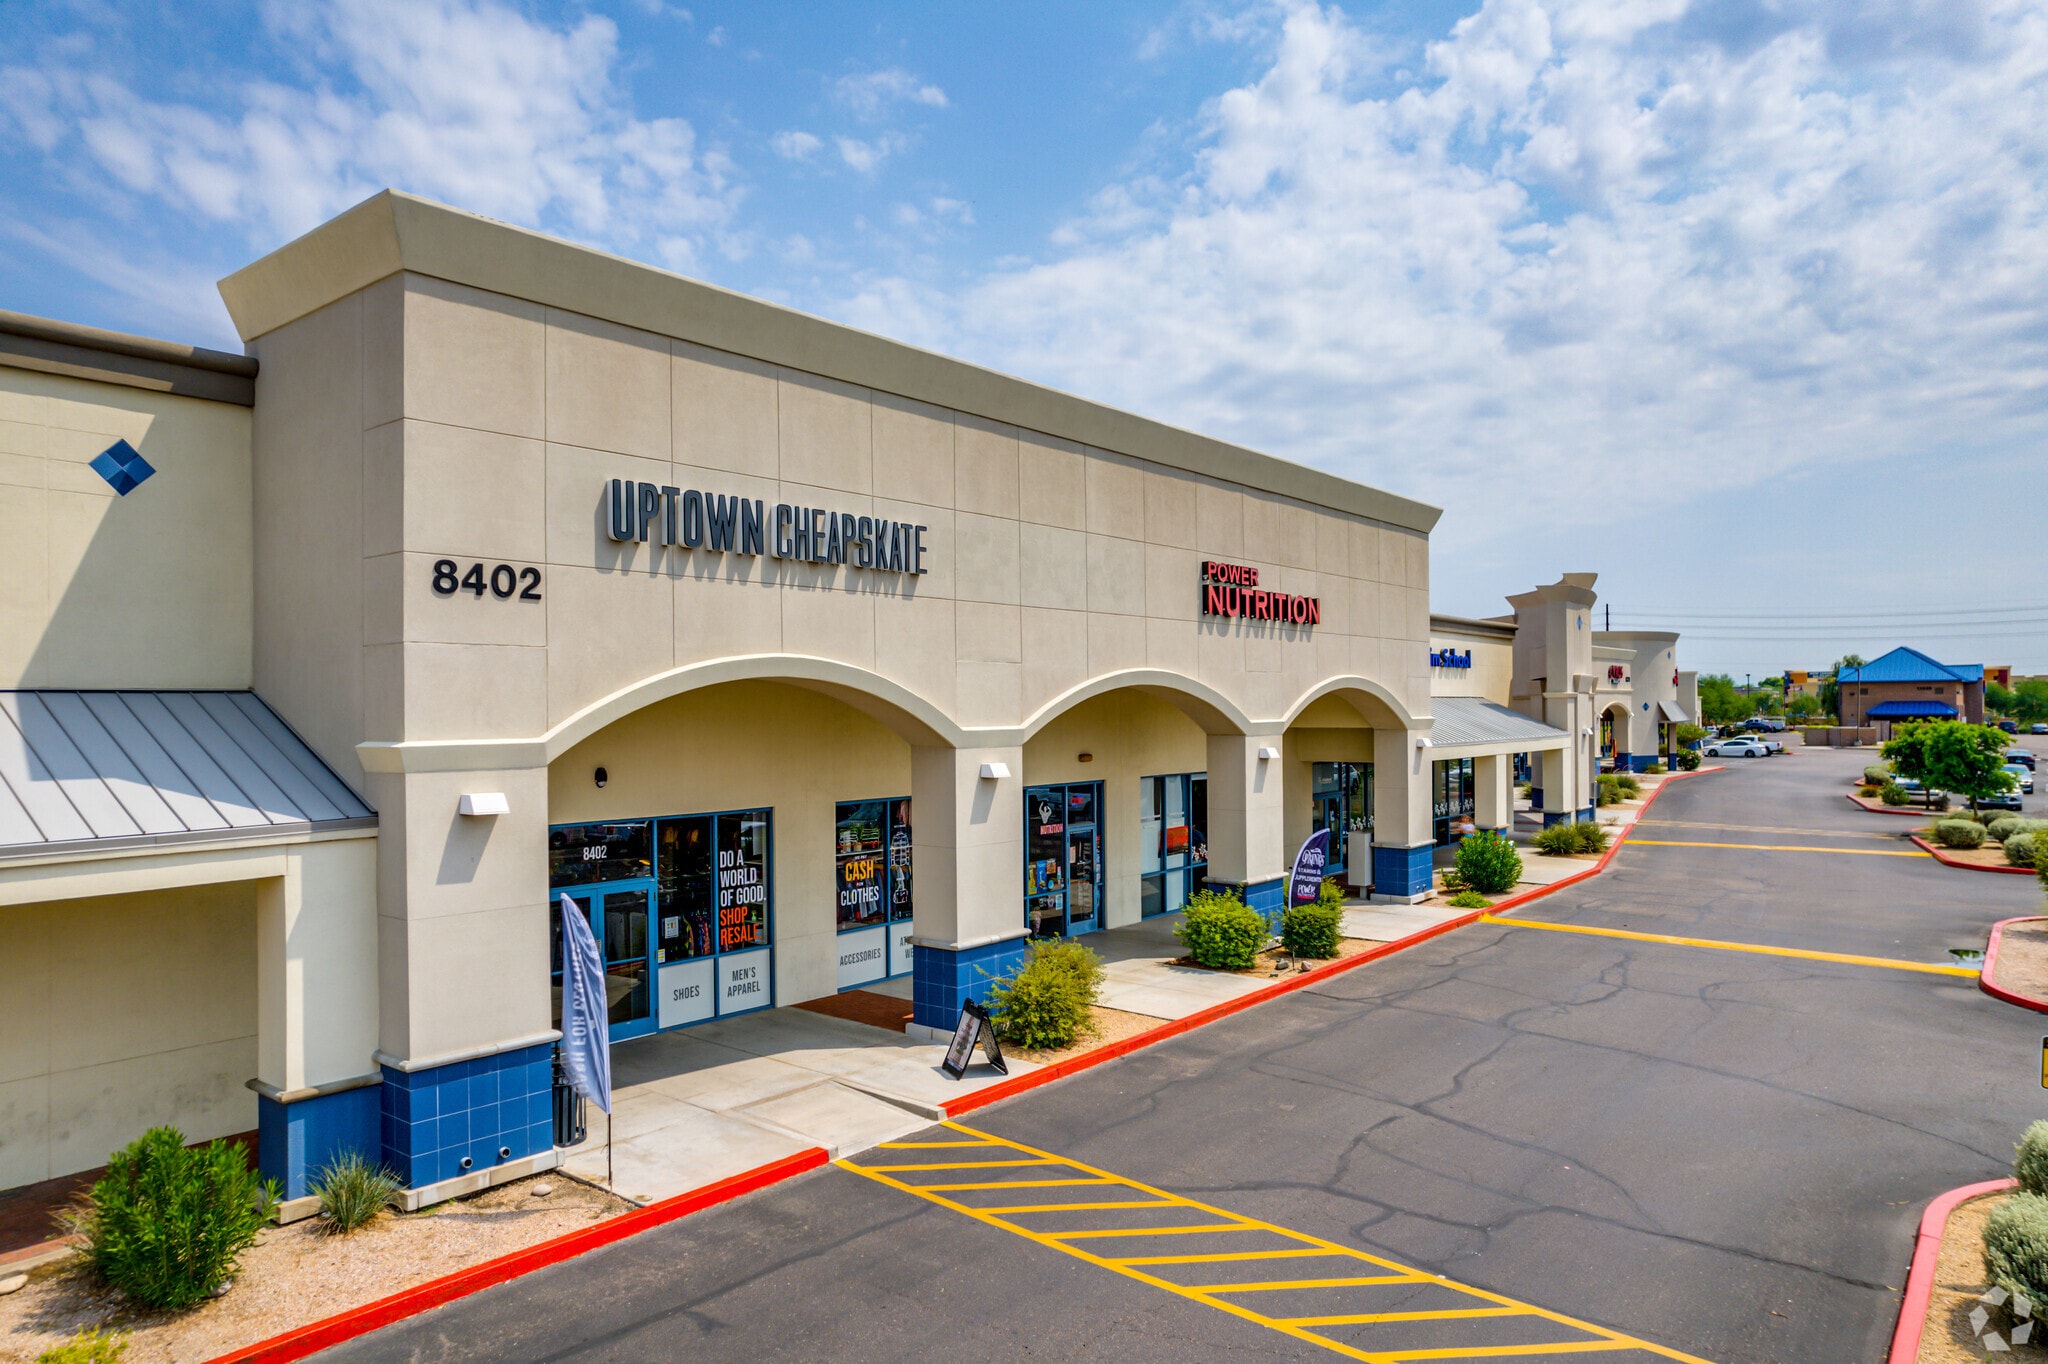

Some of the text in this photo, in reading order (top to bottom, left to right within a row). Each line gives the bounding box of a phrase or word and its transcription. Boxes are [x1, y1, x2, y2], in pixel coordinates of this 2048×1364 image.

[608, 479, 928, 575] UPTOWN CHEAPSKATE
[432, 559, 542, 600] 8402
[1204, 561, 1259, 586] POWER
[1204, 585, 1320, 625] NUTRITION
[583, 845, 607, 860] 8402
[720, 848, 744, 869] DO A
[720, 867, 757, 888] WORLD
[845, 860, 874, 882] CASH
[720, 885, 767, 907] OF GOOD.
[840, 885, 880, 907] CLOTHES
[720, 906, 748, 926] SHOP
[839, 947, 882, 967] ACCESSORIES
[732, 966, 756, 982] MEN'S
[673, 985, 700, 1002] SHOES
[727, 980, 761, 998] APPAREL
